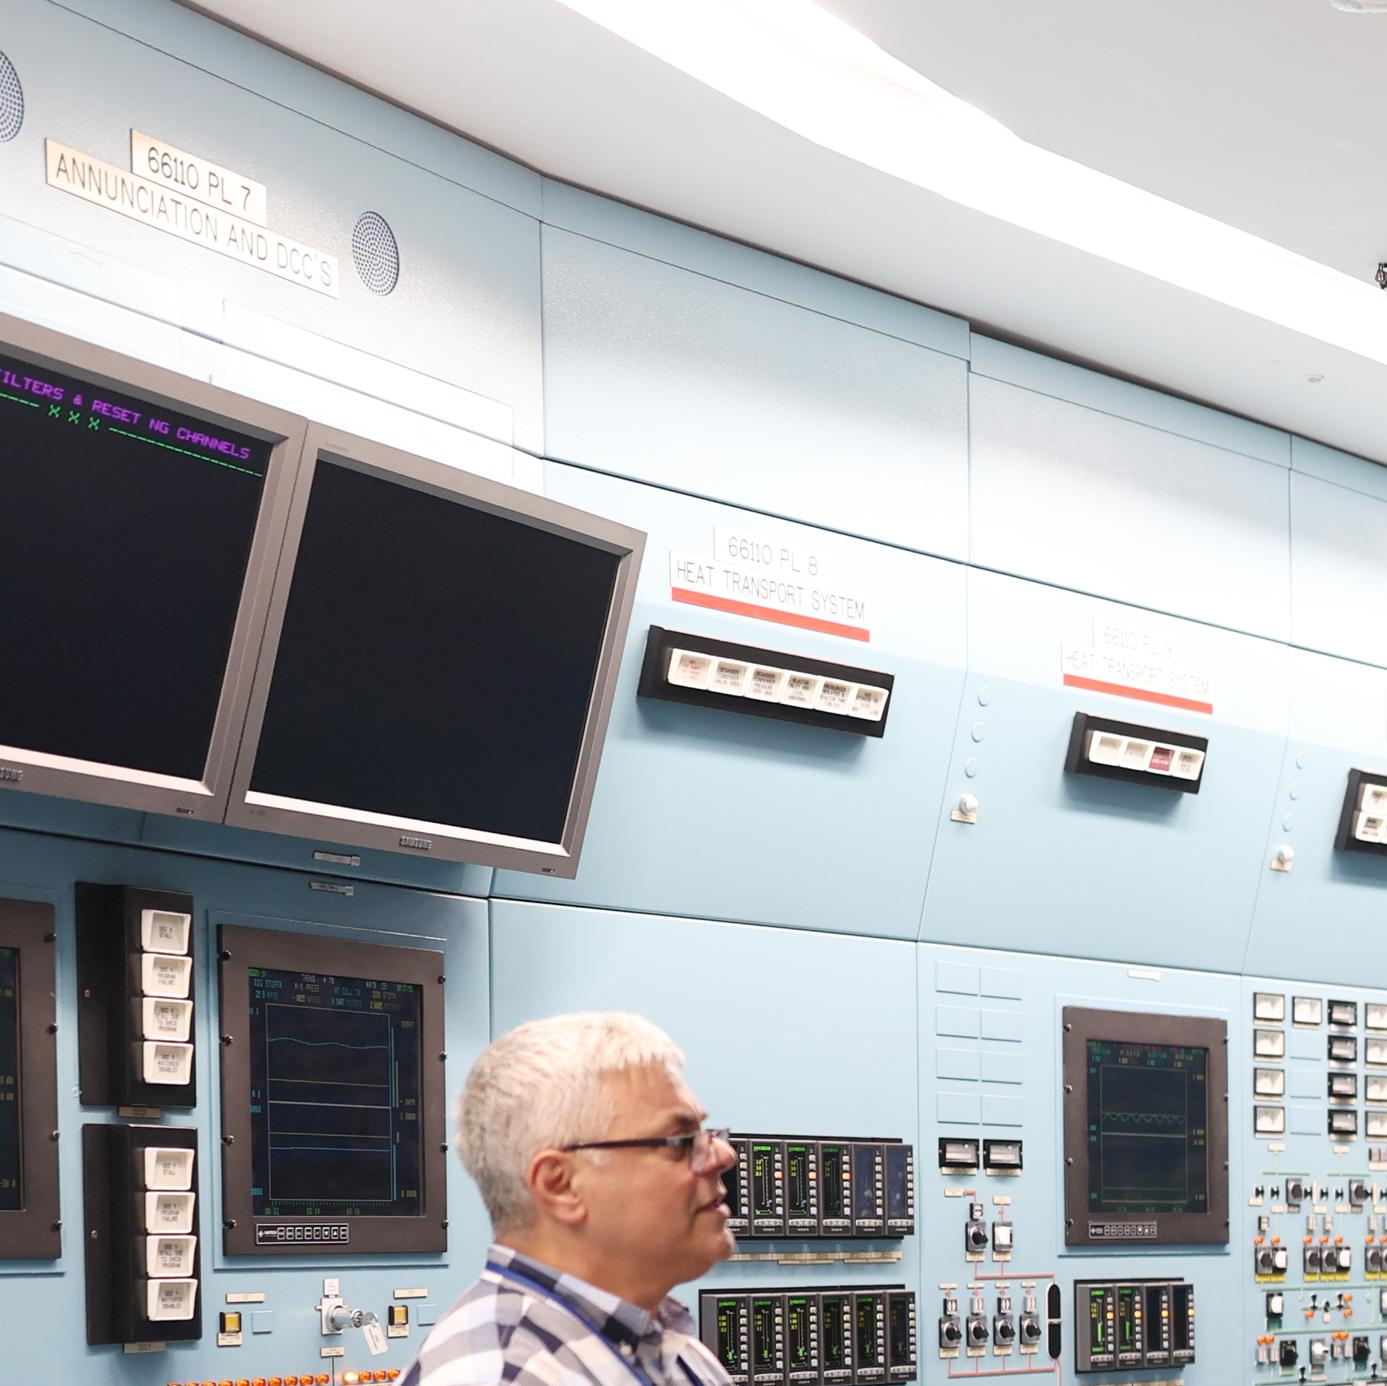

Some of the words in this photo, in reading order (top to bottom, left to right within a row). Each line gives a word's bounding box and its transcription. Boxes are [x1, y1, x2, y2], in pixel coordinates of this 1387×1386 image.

[147, 146, 200, 191] 66110
[208, 170, 233, 206] PL
[240, 185, 251, 212] 7
[56, 152, 218, 244] ANNUNCIATION
[228, 224, 268, 262] AND
[277, 241, 332, 288] DCC'S
[0, 369, 64, 401] ILTERS
[91, 399, 142, 425] RESET
[148, 418, 171, 435] NG
[176, 427, 251, 460] CHANNELS
[728, 536, 773, 565] 66110
[780, 548, 801, 573] PL
[808, 555, 819, 576] 8
[677, 560, 714, 587] HEAT
[723, 569, 804, 607] TRANSPORT
[812, 590, 865, 621] SYSTEM
